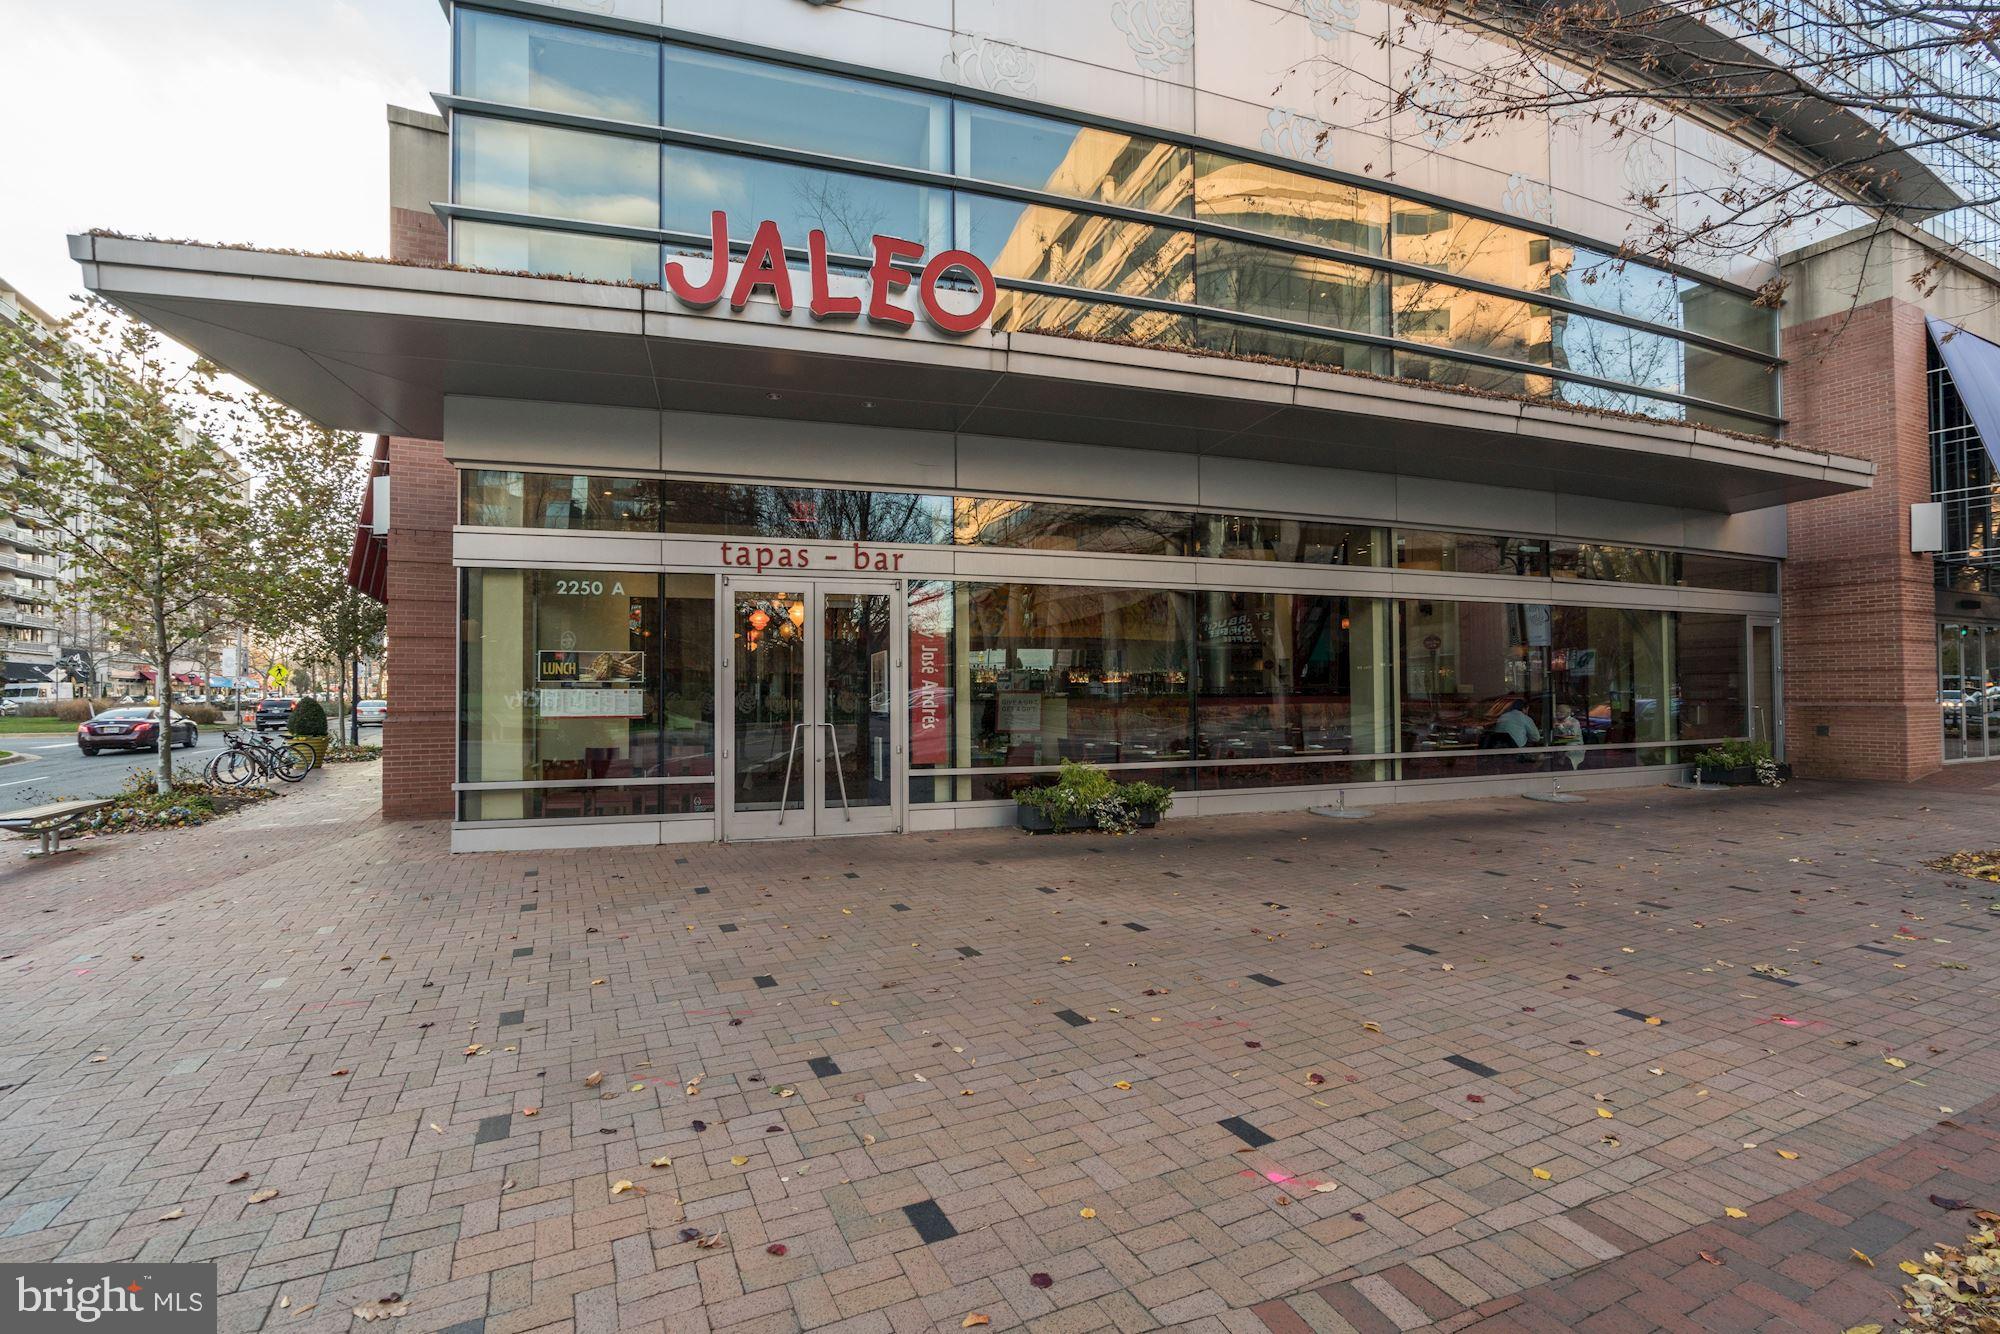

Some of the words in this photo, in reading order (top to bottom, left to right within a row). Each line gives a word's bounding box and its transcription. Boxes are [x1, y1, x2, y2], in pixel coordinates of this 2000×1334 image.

[664, 210, 997, 337] JALEO
[721, 542, 809, 573] tapas
[853, 542, 904, 571] bar
[556, 580, 603, 596] 2250
[611, 582, 625, 596] A
[542, 661, 576, 675] LUNCH
[921, 644, 938, 674] José
[921, 679, 939, 730] Andrés
